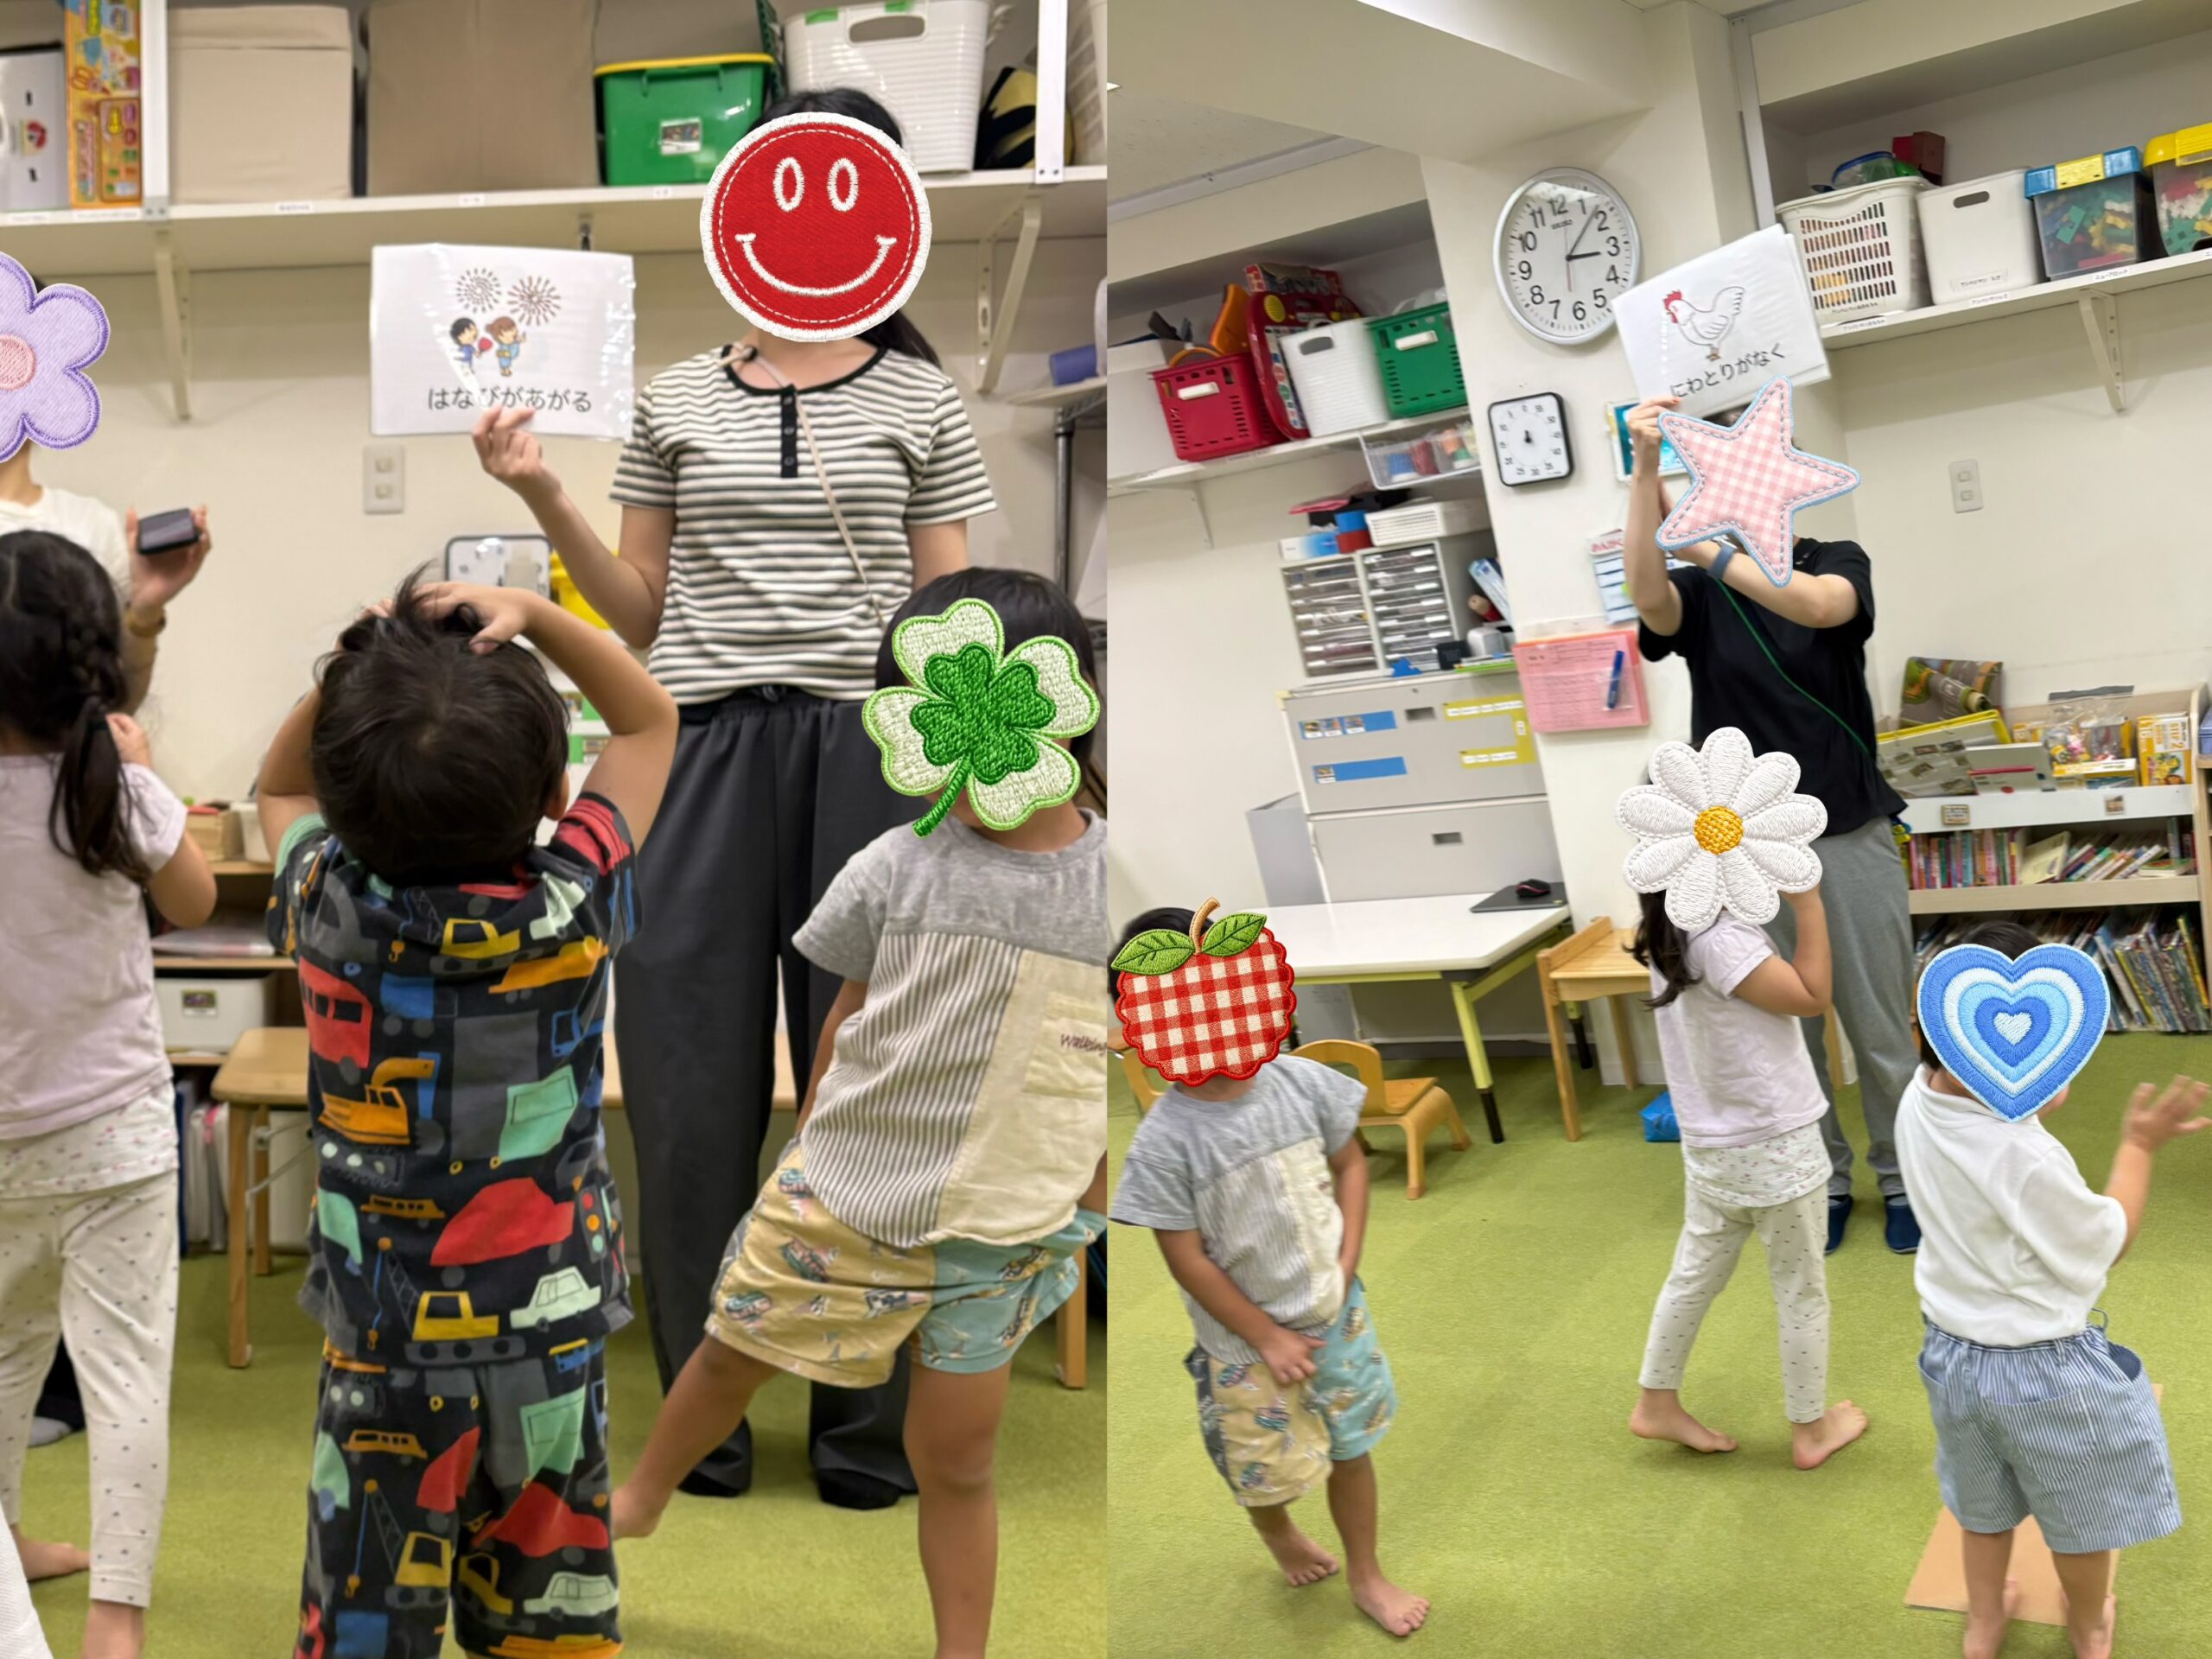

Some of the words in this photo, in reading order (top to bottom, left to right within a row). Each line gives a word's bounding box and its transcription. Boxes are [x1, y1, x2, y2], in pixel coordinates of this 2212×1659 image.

[1547, 194, 1569, 216] 12
[1578, 197, 1586, 215] 1
[1529, 207, 1546, 229] 11
[1595, 210, 1610, 232] 2
[1519, 231, 1537, 252] 10
[1605, 236, 1620, 257] 3
[1518, 260, 1532, 281] 9
[1605, 264, 1620, 284] 4
[1529, 285, 1545, 305] 8
[1593, 288, 1607, 308] 5
[1548, 299, 1561, 320] 7
[1573, 301, 1586, 321] 6
[1670, 343, 1785, 397] にわとりがなく
[429, 385, 592, 413] はなびがあがる
